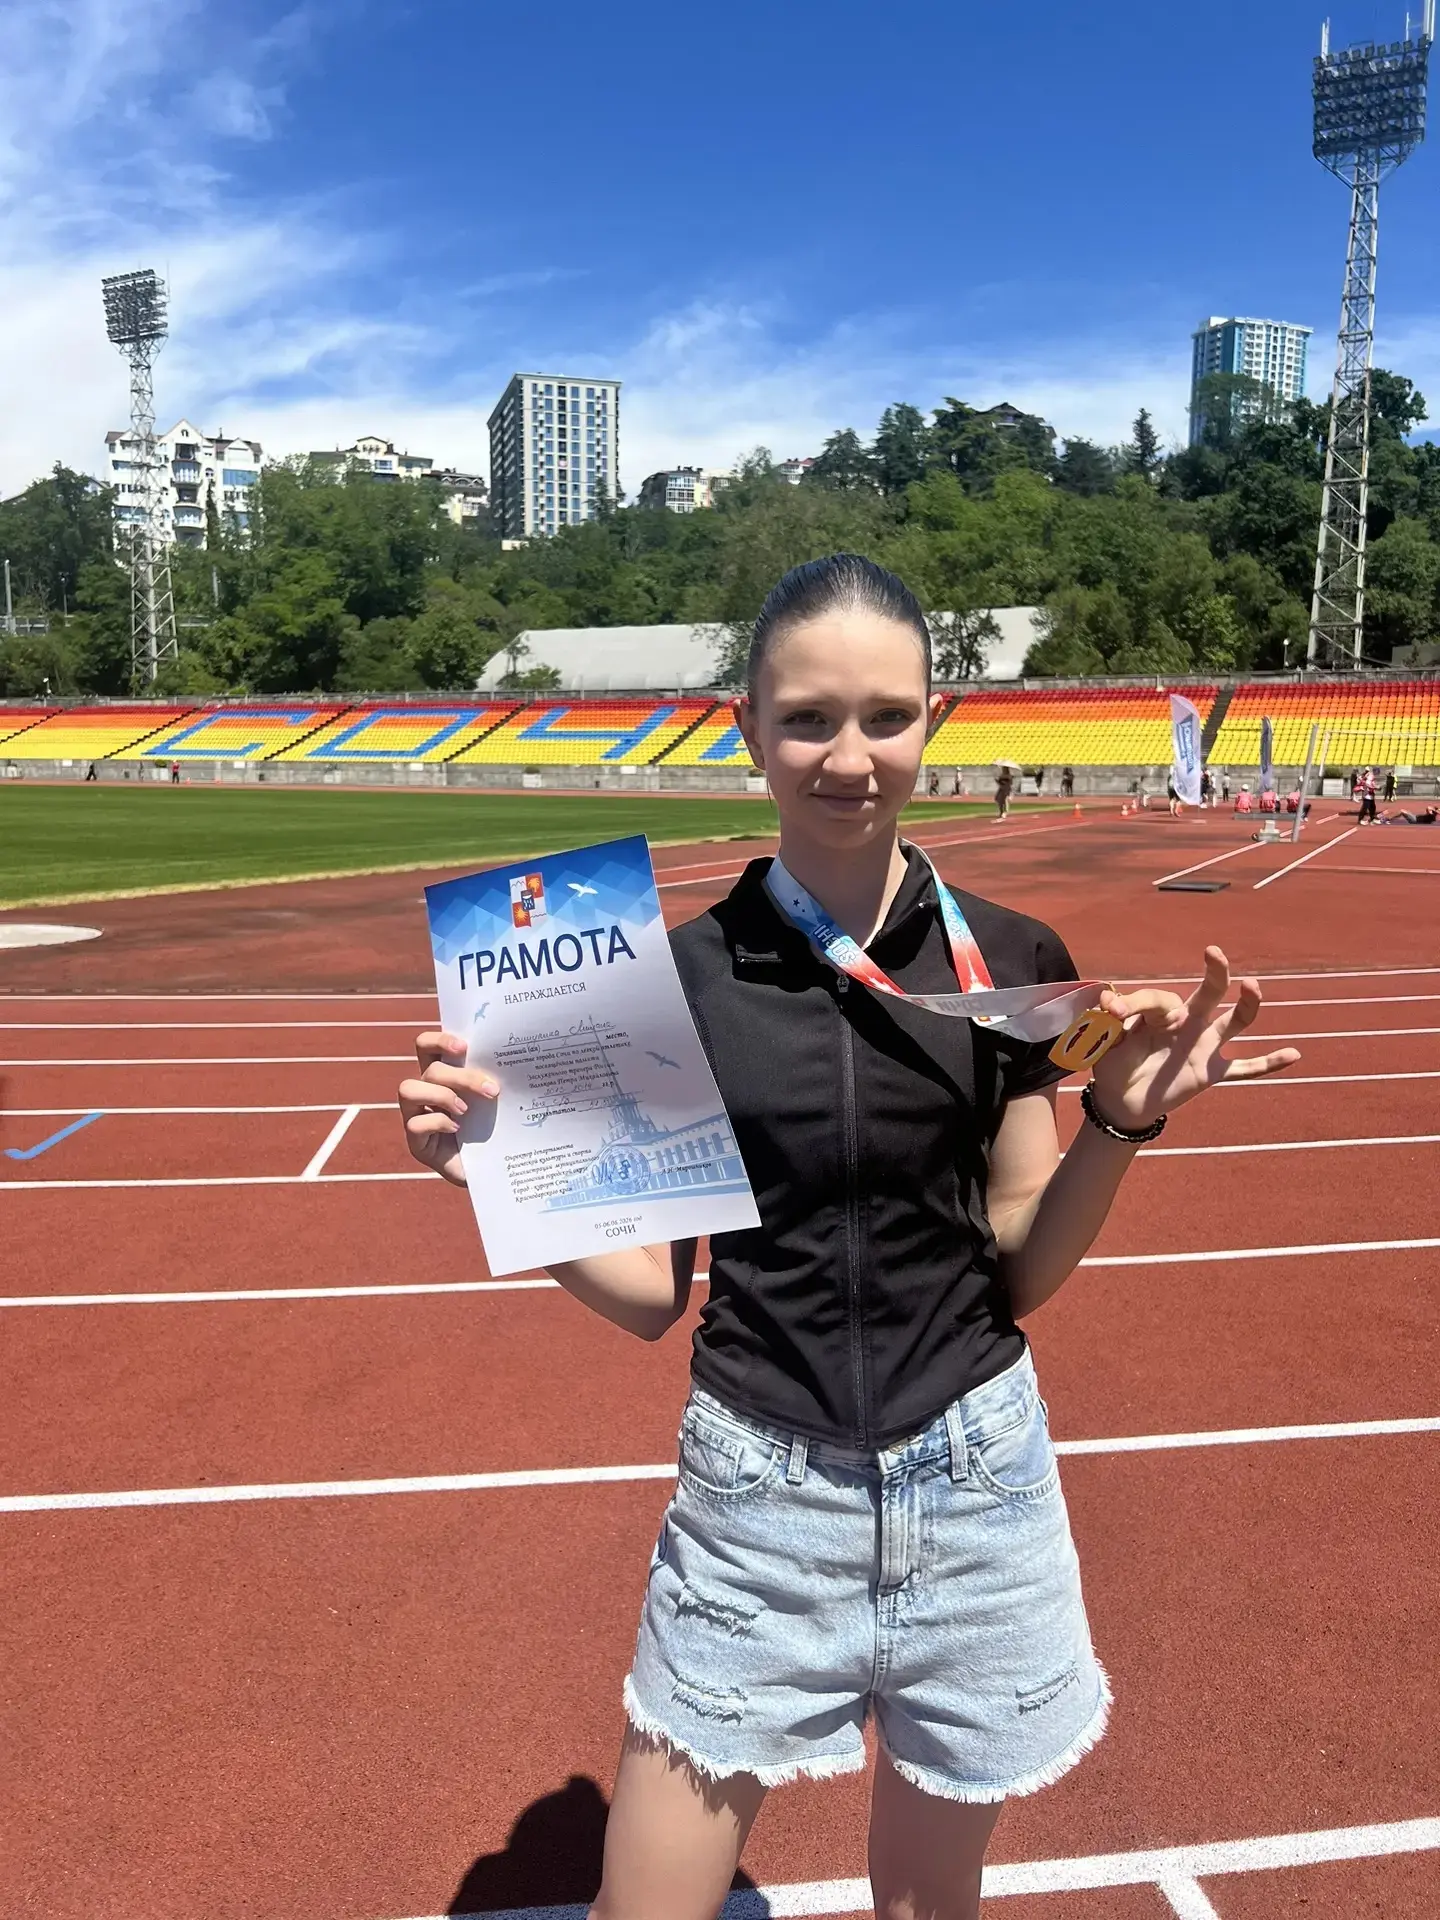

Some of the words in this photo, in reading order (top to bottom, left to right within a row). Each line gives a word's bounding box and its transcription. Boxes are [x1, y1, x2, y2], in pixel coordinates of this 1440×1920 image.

[813, 924, 857, 964] SOCHI
[458, 925, 637, 990] ГРАМОТА
[504, 982, 587, 1004] НАГРАЖДАЕТСЯ
[536, 1053, 555, 1063] города
[531, 1107, 576, 1122] результатом
[605, 1223, 636, 1238] СОЧИ
